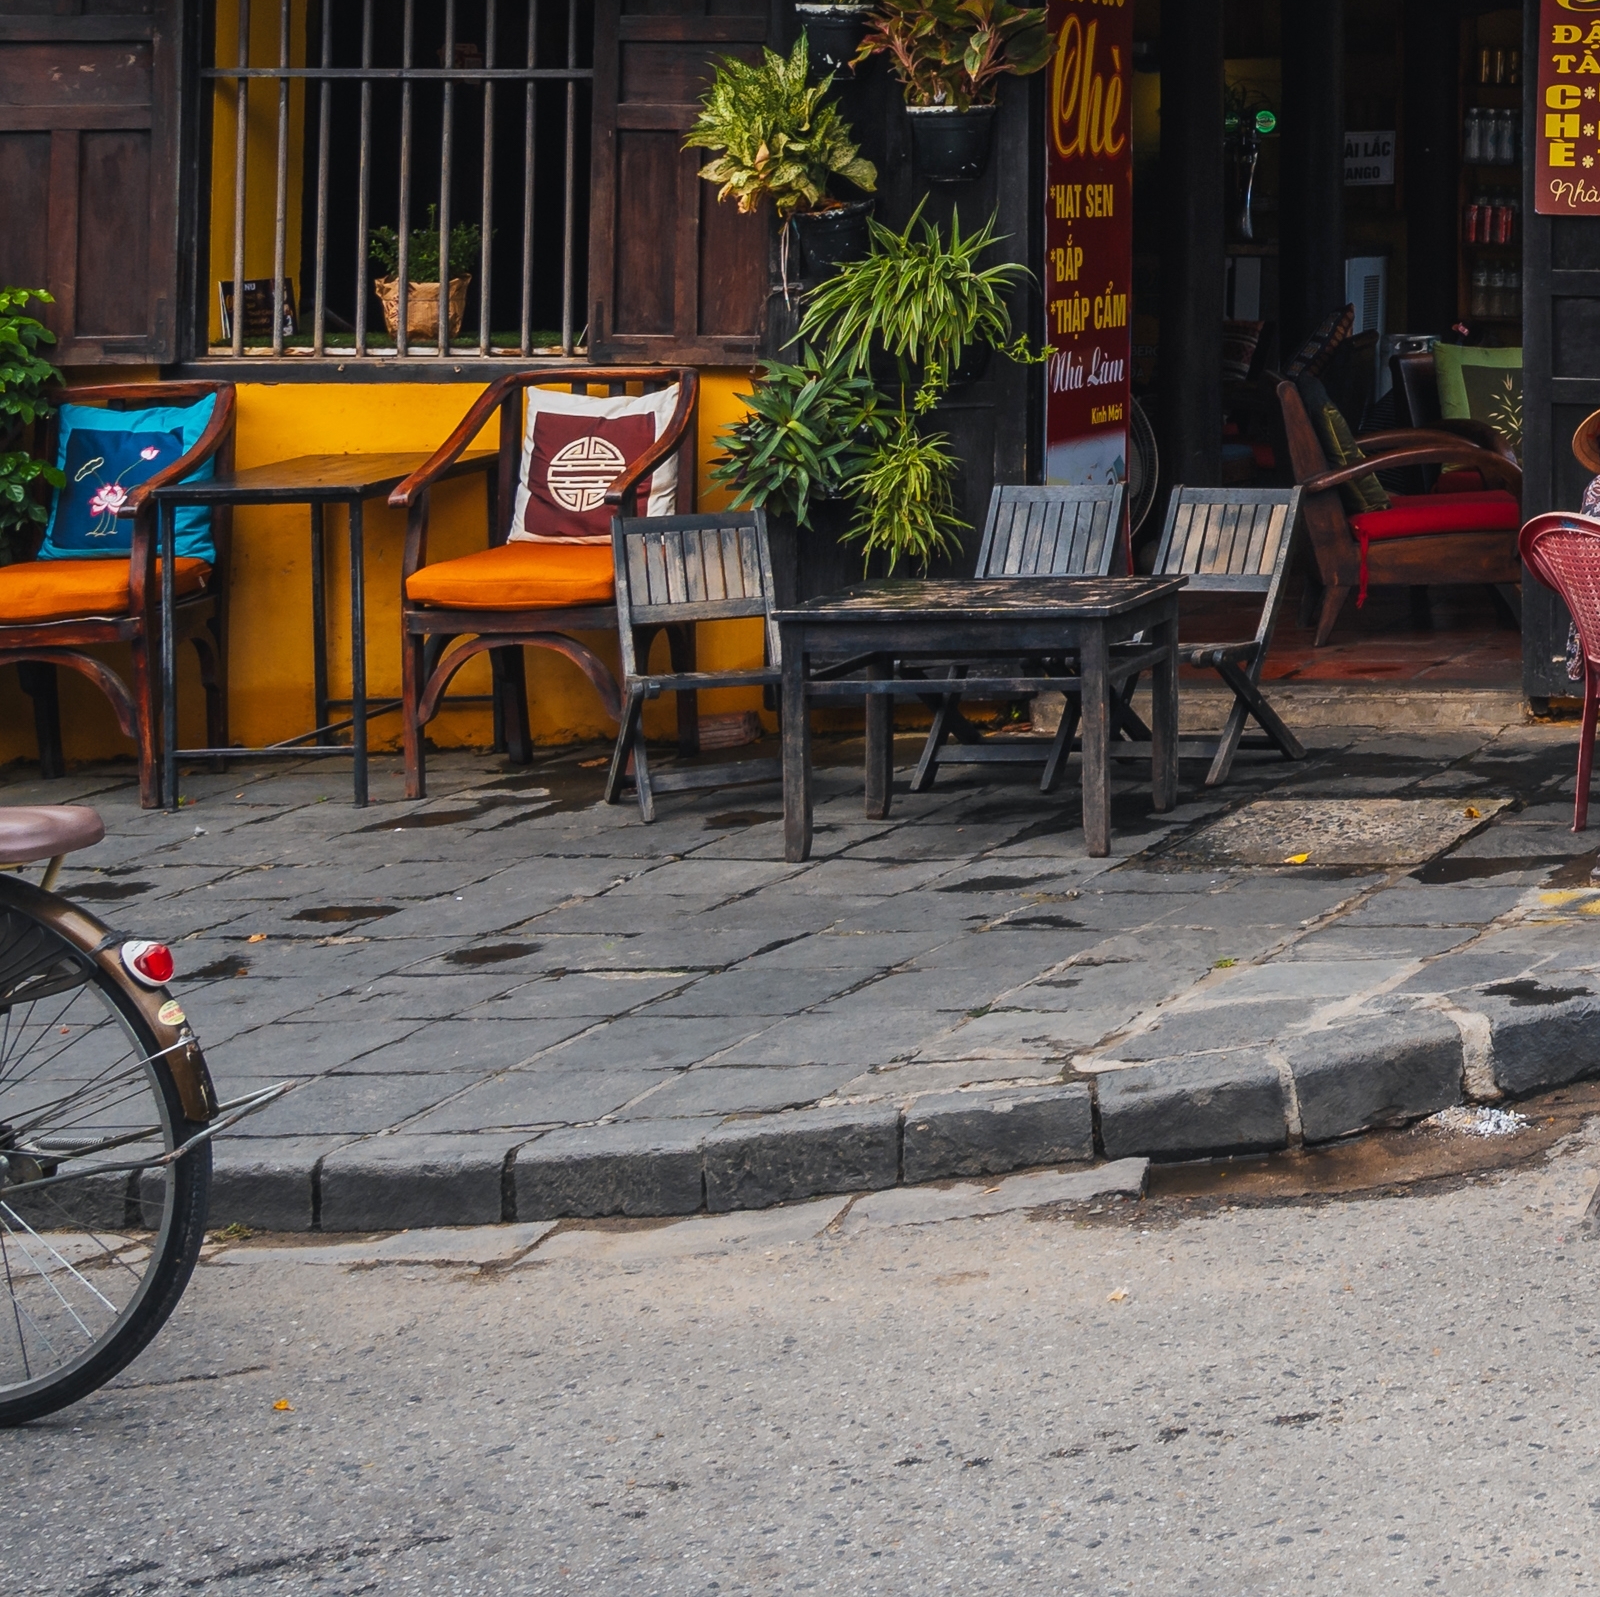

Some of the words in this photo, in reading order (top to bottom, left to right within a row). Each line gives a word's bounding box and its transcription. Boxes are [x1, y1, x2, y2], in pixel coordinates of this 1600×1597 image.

[1052, 12, 1125, 159] Chè
[1344, 138, 1359, 159] ÀI
[1363, 135, 1391, 158] LẮC
[1345, 166, 1381, 181] ANGO
[1055, 183, 1083, 227] HẠT
[1085, 183, 1114, 218] SEN
[1055, 233, 1083, 283] BẮP
[243, 282, 256, 291] NU
[1055, 290, 1090, 340] THẬP
[1094, 280, 1127, 330] CẨM
[1049, 351, 1084, 394] Nhà
[1087, 346, 1125, 387] Làm
